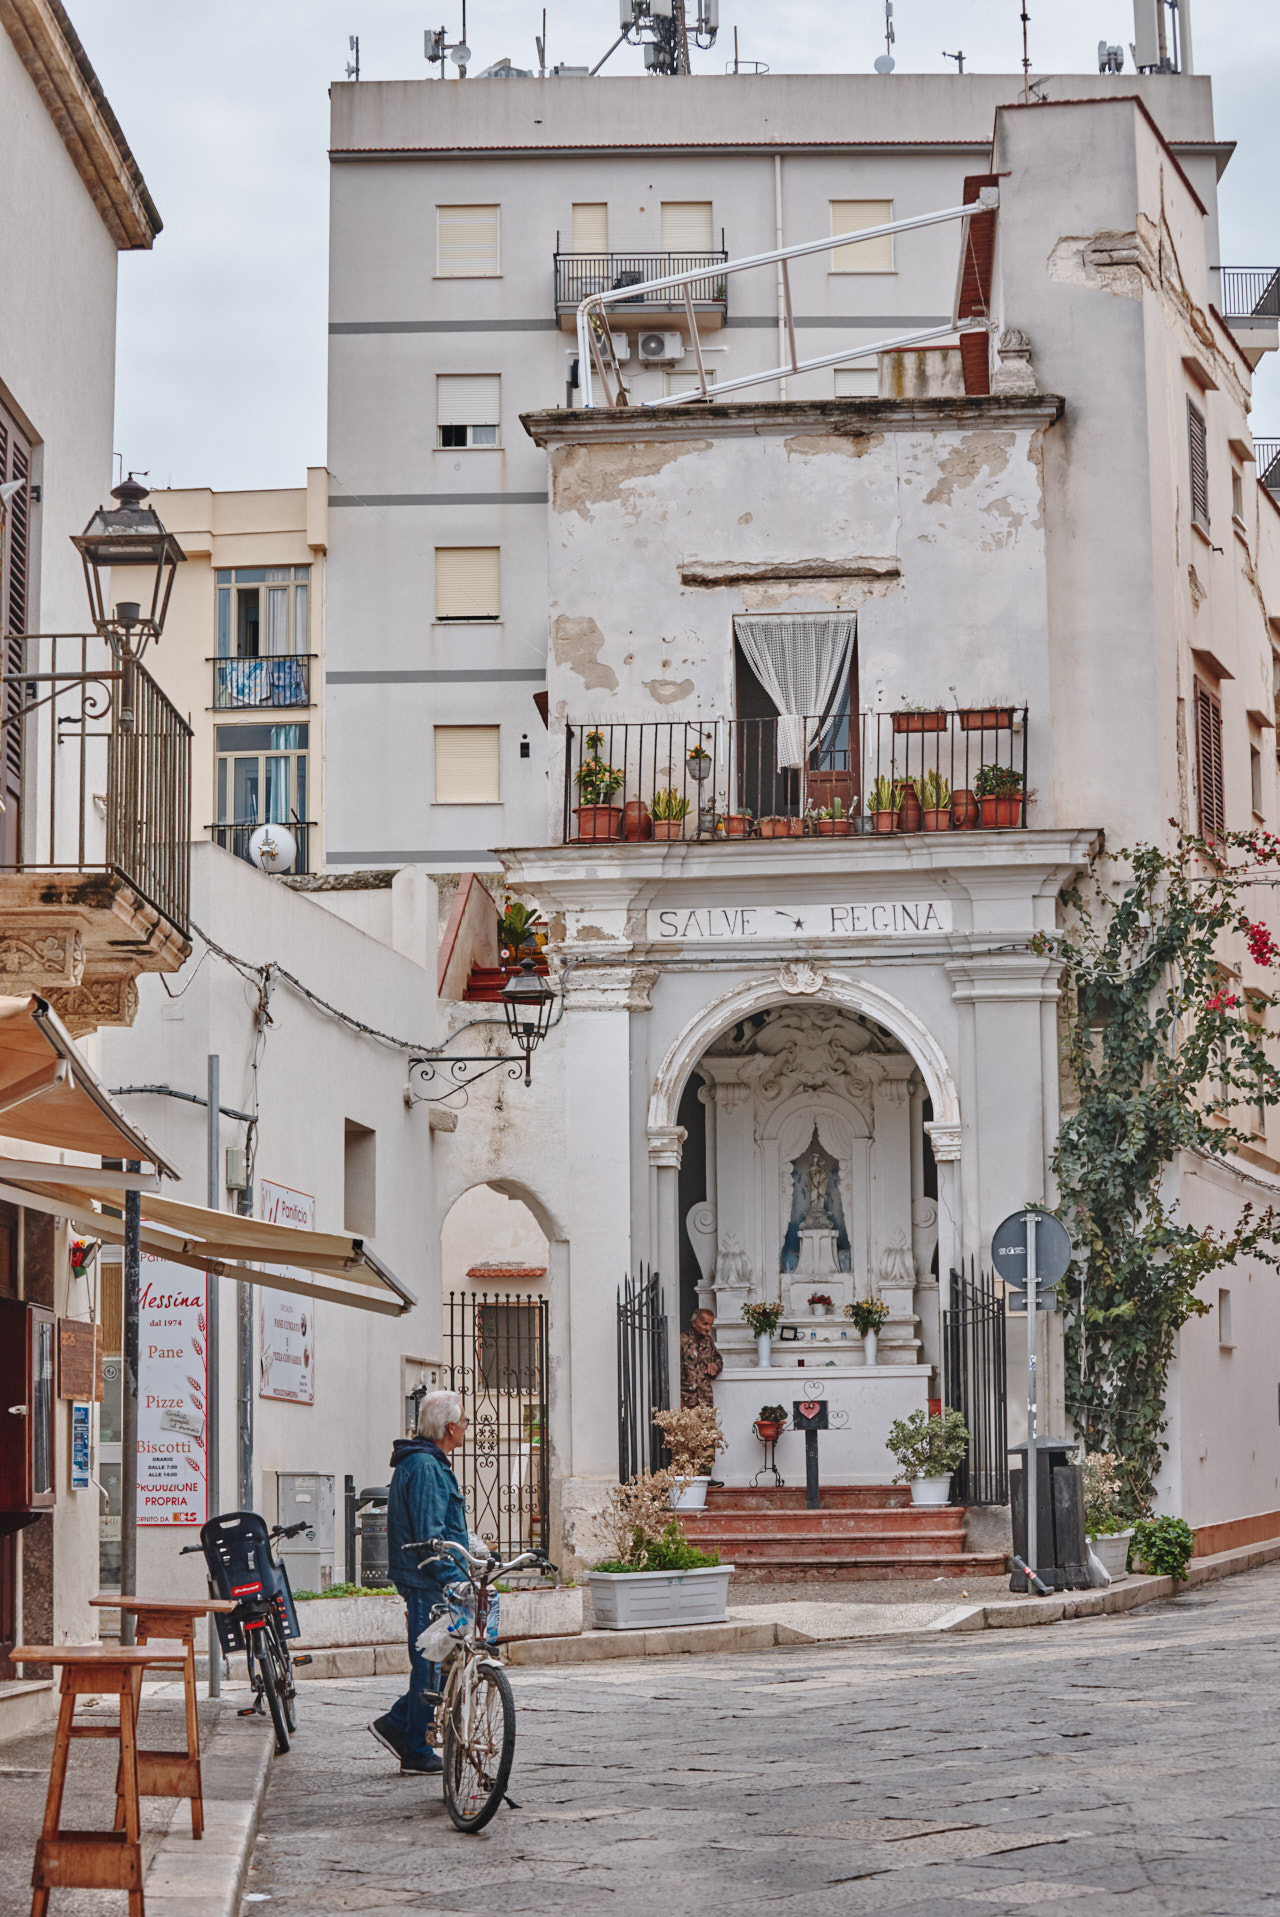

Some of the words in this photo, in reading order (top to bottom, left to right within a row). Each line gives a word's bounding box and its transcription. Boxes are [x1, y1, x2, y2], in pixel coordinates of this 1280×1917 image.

[659, 908, 758, 938] SALVE
[830, 902, 944, 933] REGINA
[281, 1200, 308, 1225] Panificio
[149, 1319, 162, 1327] dal
[163, 1319, 182, 1327] 1974
[147, 1345, 184, 1359] Pane
[145, 1395, 184, 1409] Pizze
[136, 1440, 192, 1453] Biscotti
[145, 1496, 188, 1506] PROPRIA
